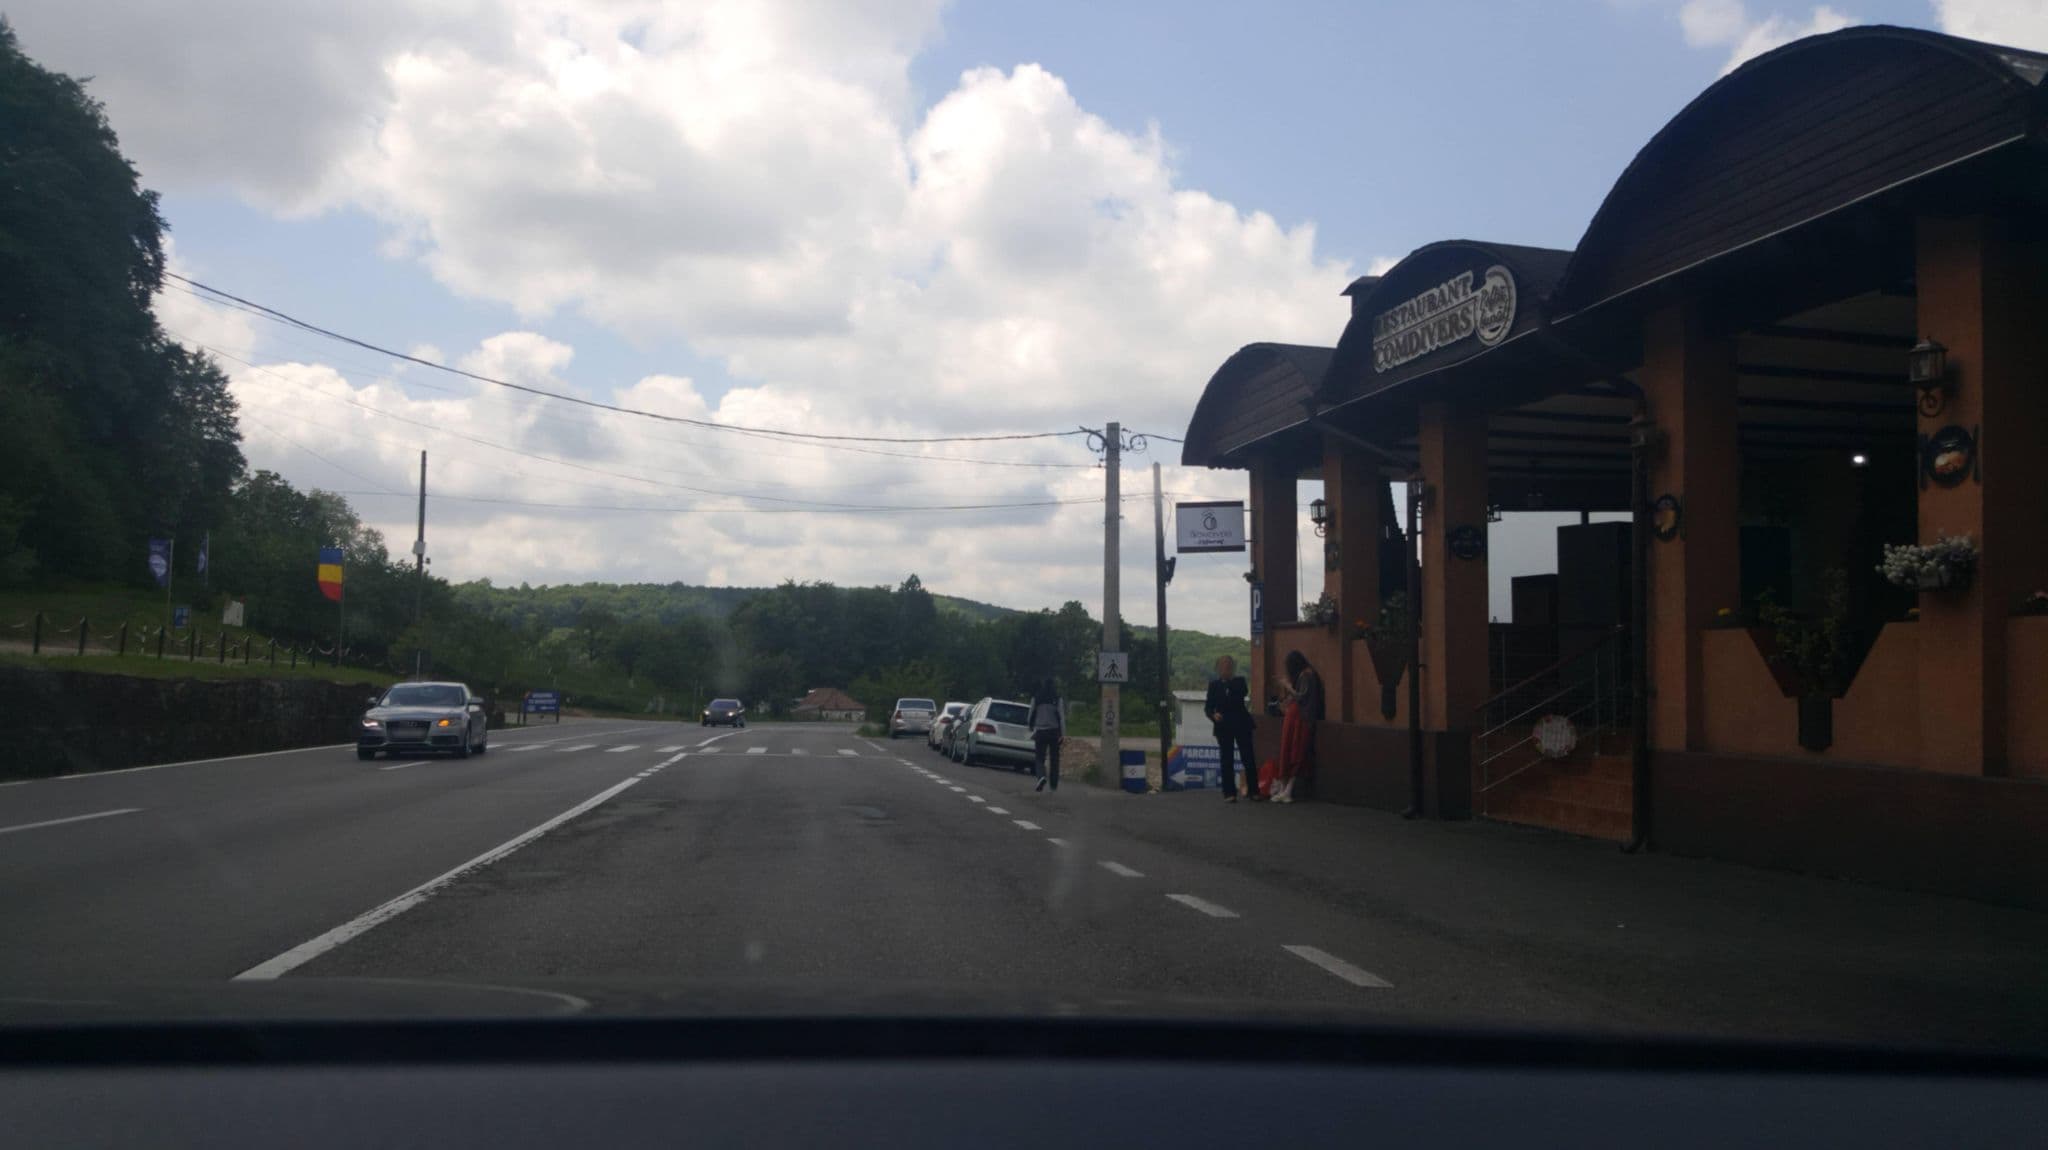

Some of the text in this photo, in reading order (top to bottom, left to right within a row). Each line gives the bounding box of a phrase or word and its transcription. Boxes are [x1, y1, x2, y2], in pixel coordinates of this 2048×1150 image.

[1377, 274, 1473, 334] ESTAURANT
[1375, 305, 1473, 368] COMDIVERS
[1253, 589, 1261, 621] P
